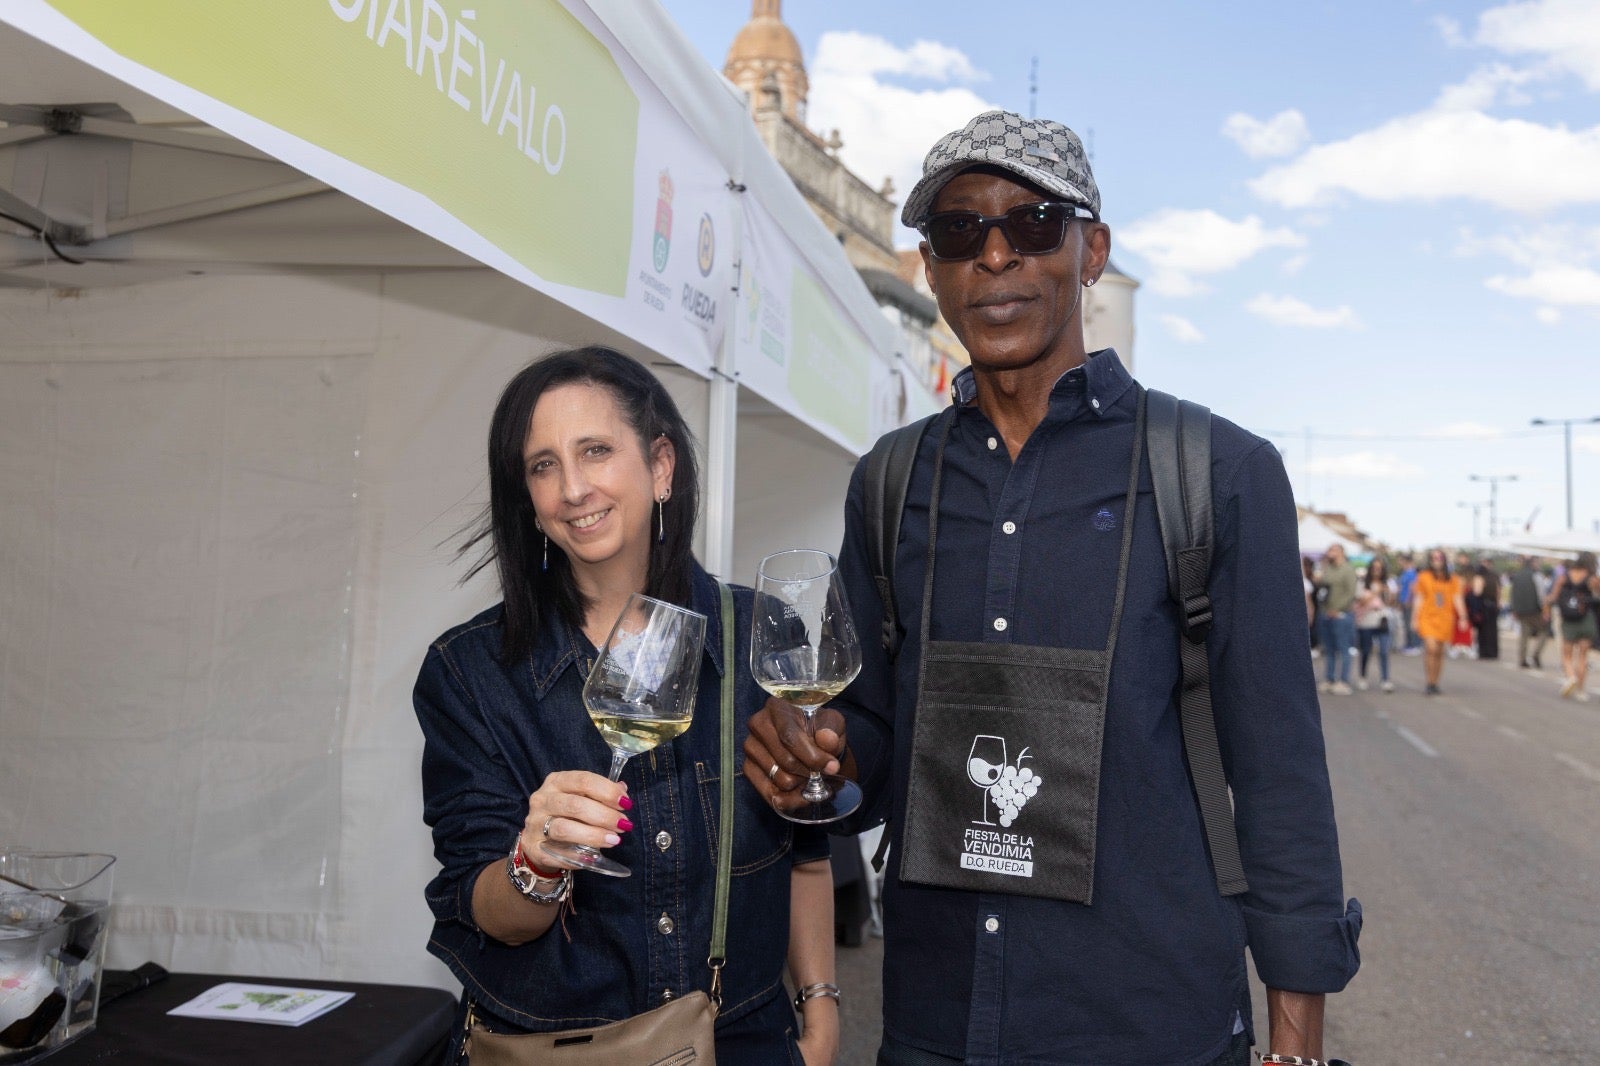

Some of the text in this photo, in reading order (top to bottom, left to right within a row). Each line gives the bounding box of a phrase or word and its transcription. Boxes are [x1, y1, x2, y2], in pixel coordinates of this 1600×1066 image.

[681, 282, 716, 325] RUEDA
[964, 828, 1034, 847] FIESTA DE LA
[963, 839, 1032, 860] VENDIMIA
[966, 856, 1026, 873] D.O. RUEDA
